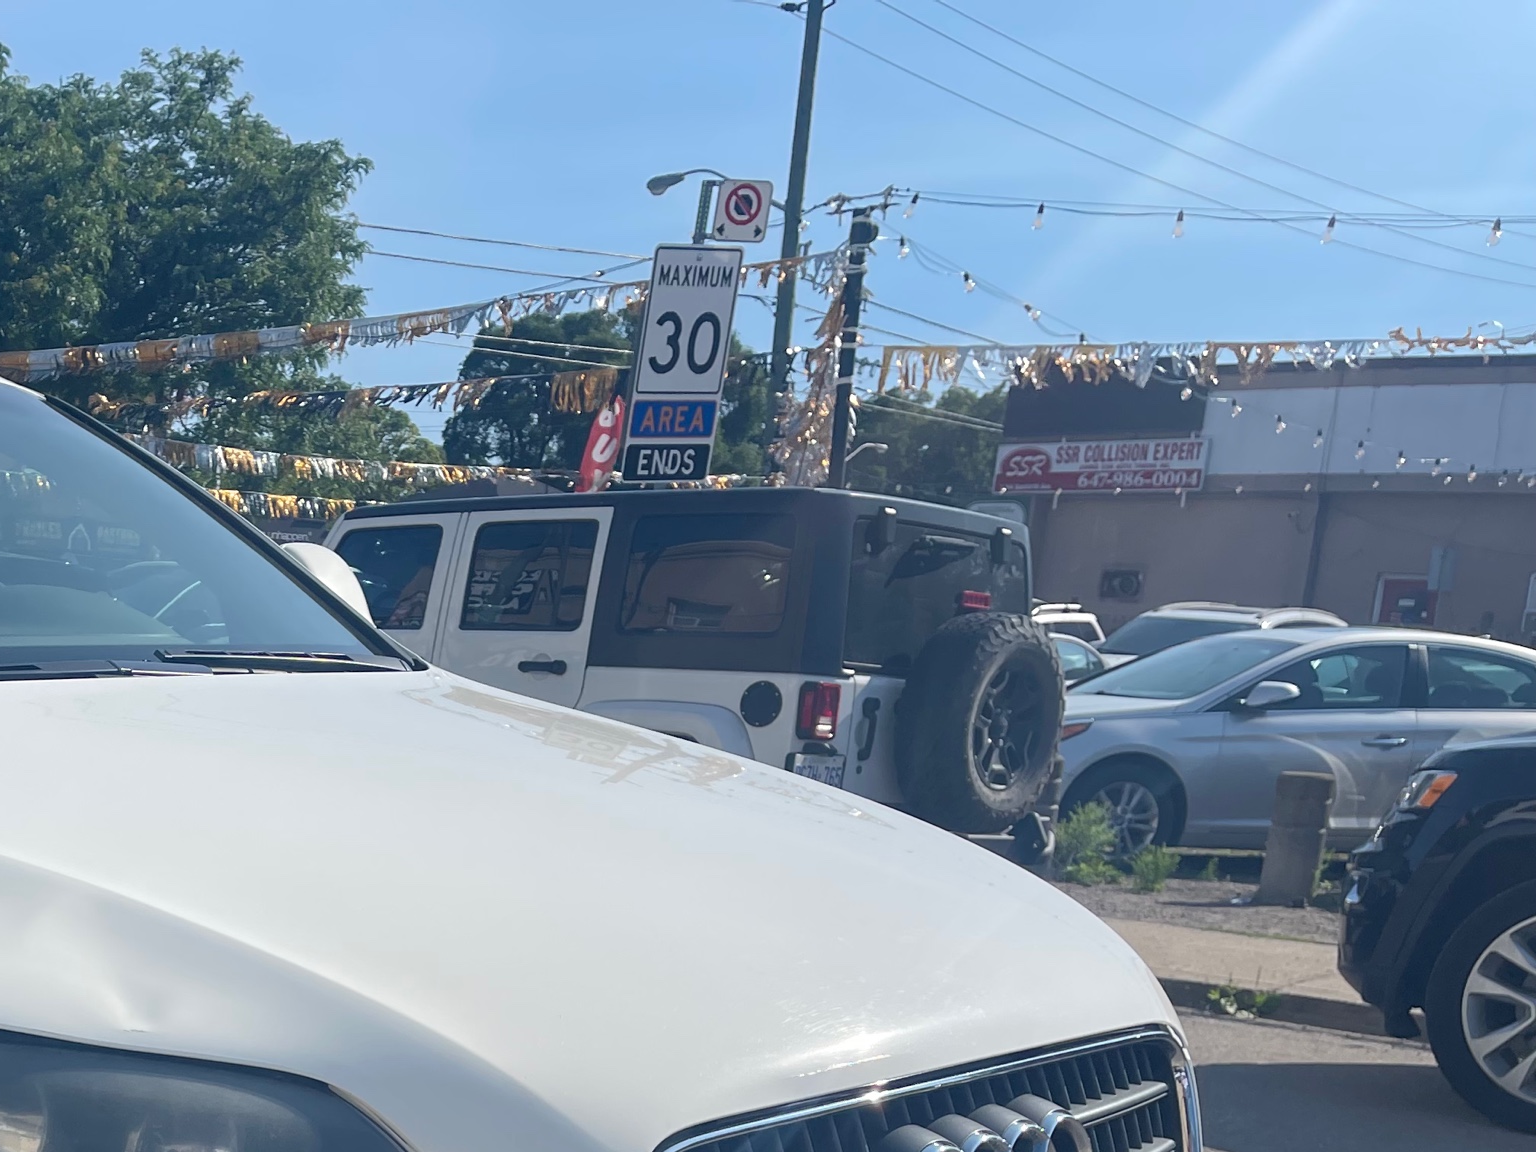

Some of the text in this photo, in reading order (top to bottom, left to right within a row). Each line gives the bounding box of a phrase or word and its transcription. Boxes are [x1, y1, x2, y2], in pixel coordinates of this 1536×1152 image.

[658, 264, 734, 288] MAXIMUM
[649, 311, 721, 375] 30
[639, 405, 705, 434] AREA
[637, 448, 696, 476] ENDS
[1055, 441, 1204, 465] SSR COLLISION EXPERT
[1006, 454, 1048, 477] SSR
[1077, 470, 1199, 488] 647-986-0004
